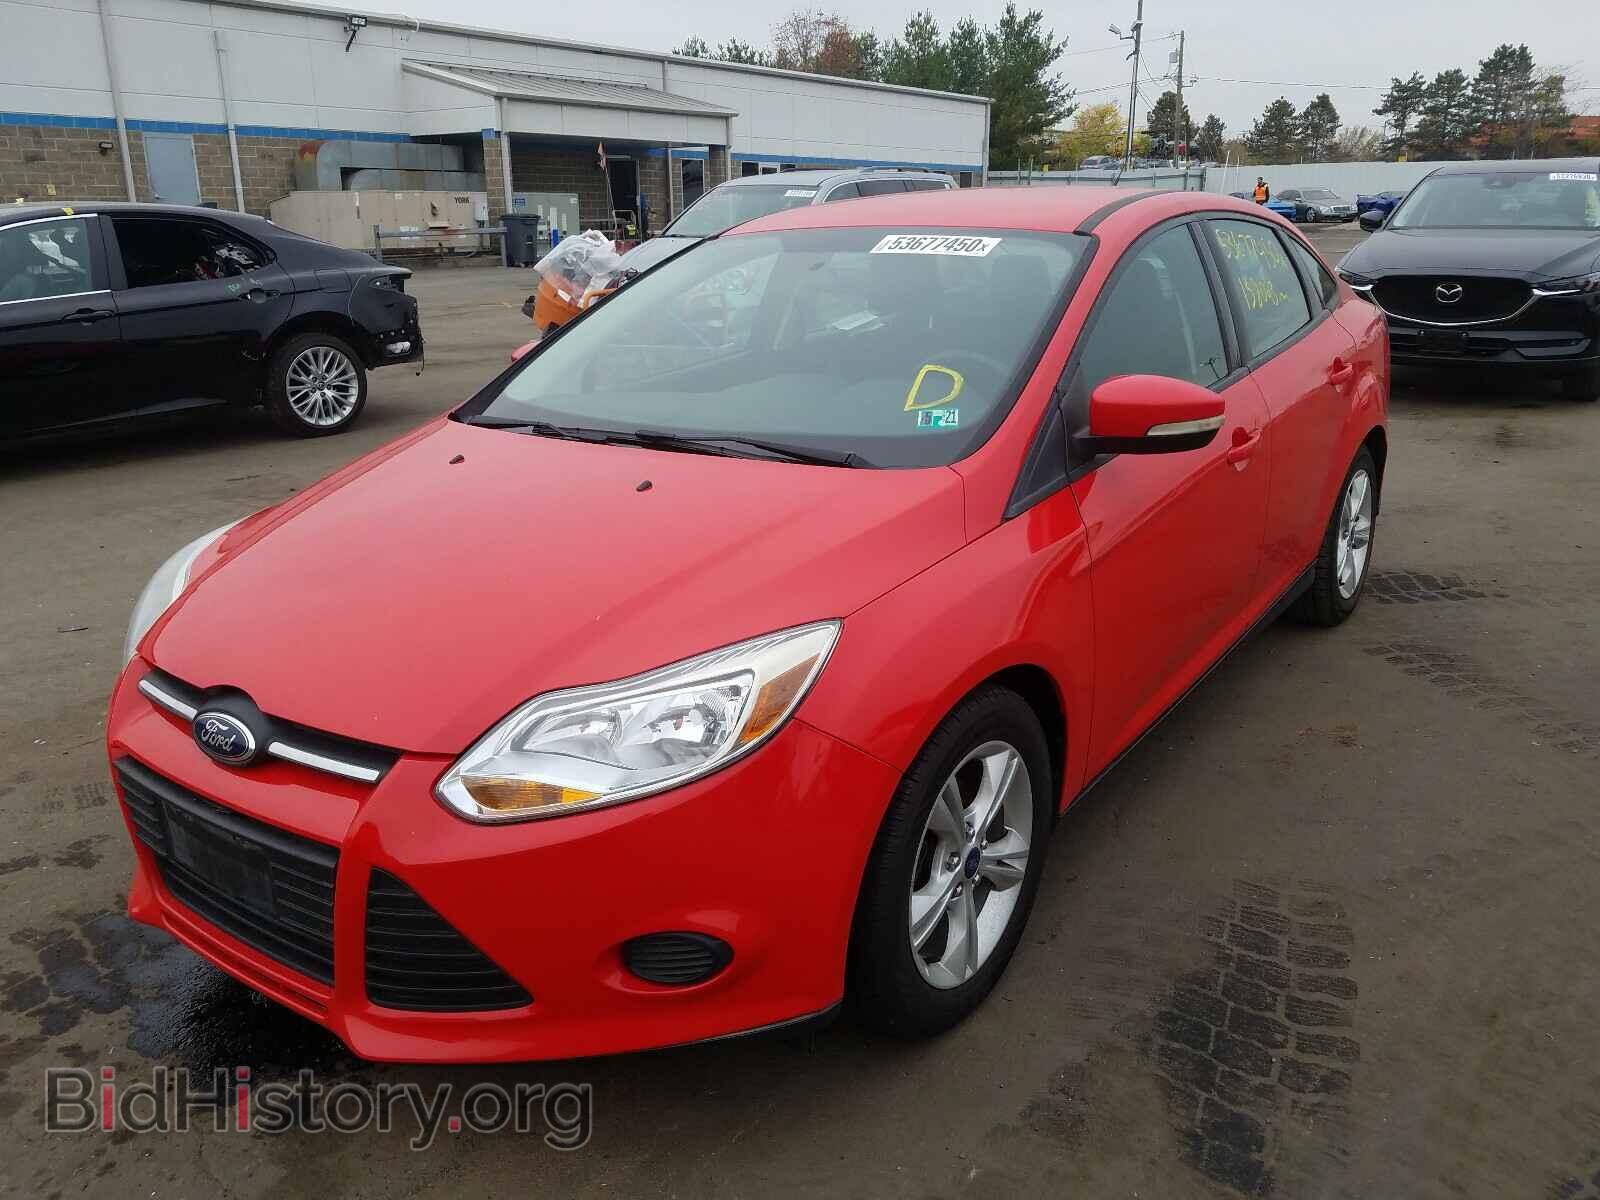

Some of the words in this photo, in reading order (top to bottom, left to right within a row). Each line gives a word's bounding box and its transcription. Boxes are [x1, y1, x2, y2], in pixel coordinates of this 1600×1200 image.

[904, 364, 964, 411] D
[945, 410, 957, 424] 21
[202, 720, 236, 752] Ford
